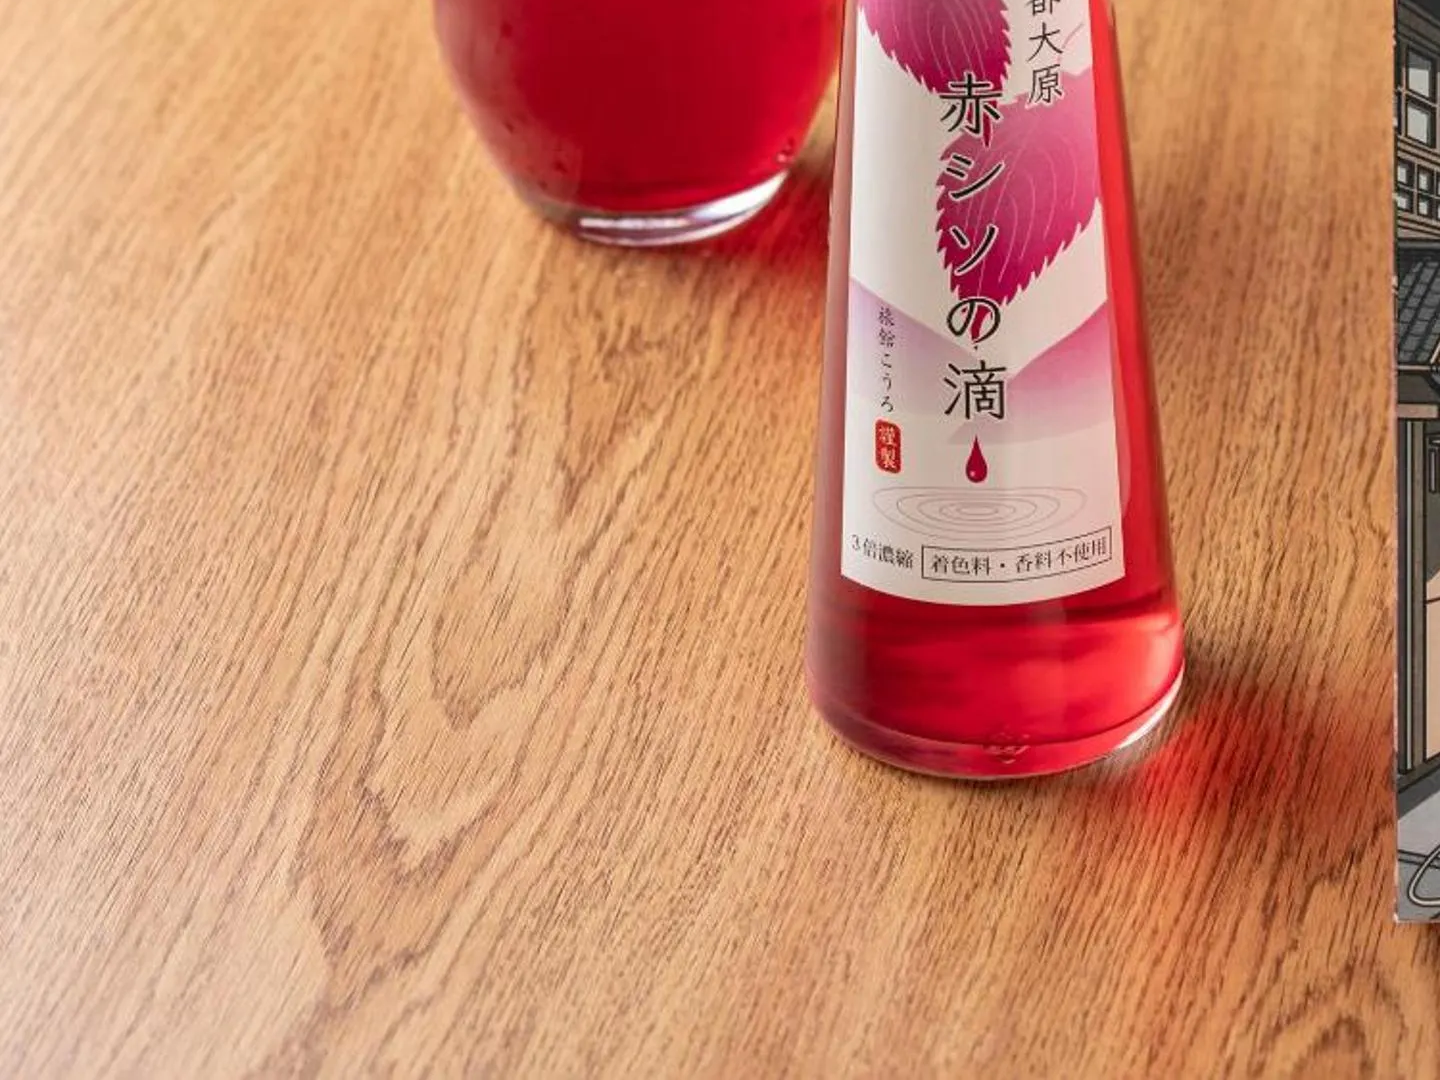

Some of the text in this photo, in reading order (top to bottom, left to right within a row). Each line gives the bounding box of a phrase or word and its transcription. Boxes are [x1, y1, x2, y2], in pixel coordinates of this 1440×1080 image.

[940, 73, 1007, 419] 赤シソの滴
[850, 532, 914, 569] 3倍濃縮
[930, 535, 1109, 576] 着色料・香料不使用
